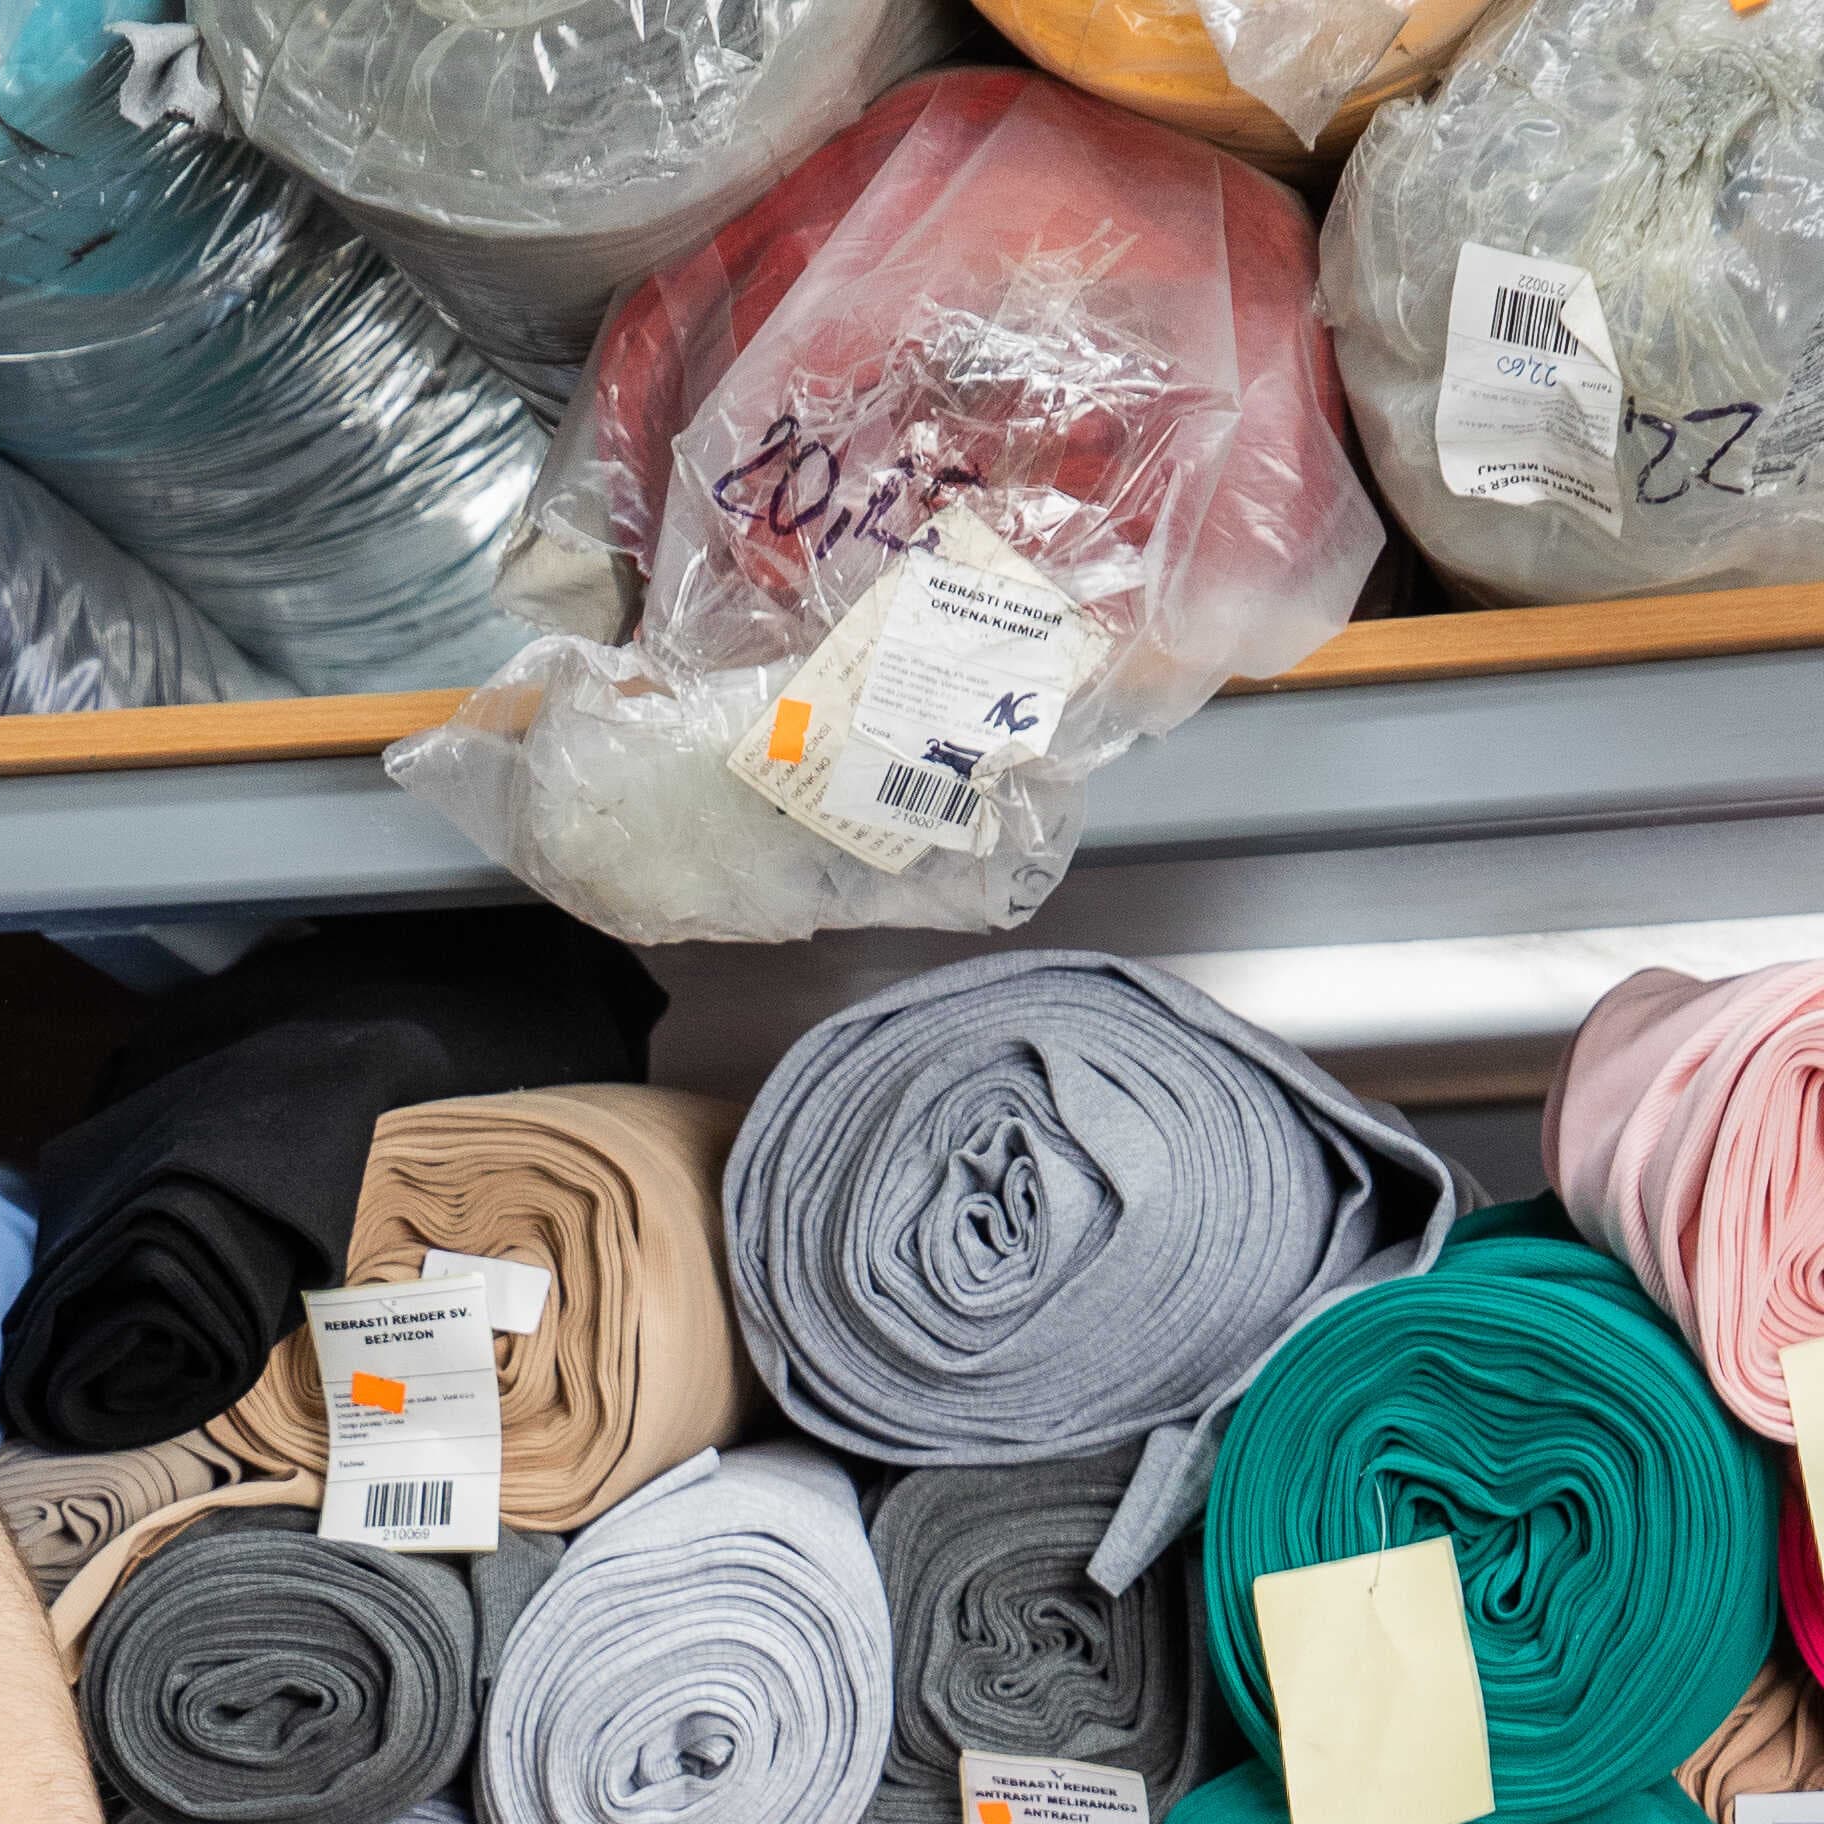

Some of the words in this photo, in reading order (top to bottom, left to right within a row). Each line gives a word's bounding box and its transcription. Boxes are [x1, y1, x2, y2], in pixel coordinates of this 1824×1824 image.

[1517, 273, 1567, 296] 210022
[1487, 472, 1549, 492] RENDER
[928, 575, 1001, 609] REBRASTI
[1004, 598, 1065, 627] RENDER
[324, 1316, 389, 1332] REBRASTI
[392, 1310, 446, 1326] RENDER
[450, 1307, 472, 1320] SV.
[364, 1329, 434, 1346] BEŽ/VIZON
[991, 1774, 1061, 1795] REBRASTI
[1063, 1782, 1118, 1798] RENDER
[1023, 1807, 1092, 1824] ANTRACIT
[1046, 1793, 1138, 1816] MELIRANA/G3
